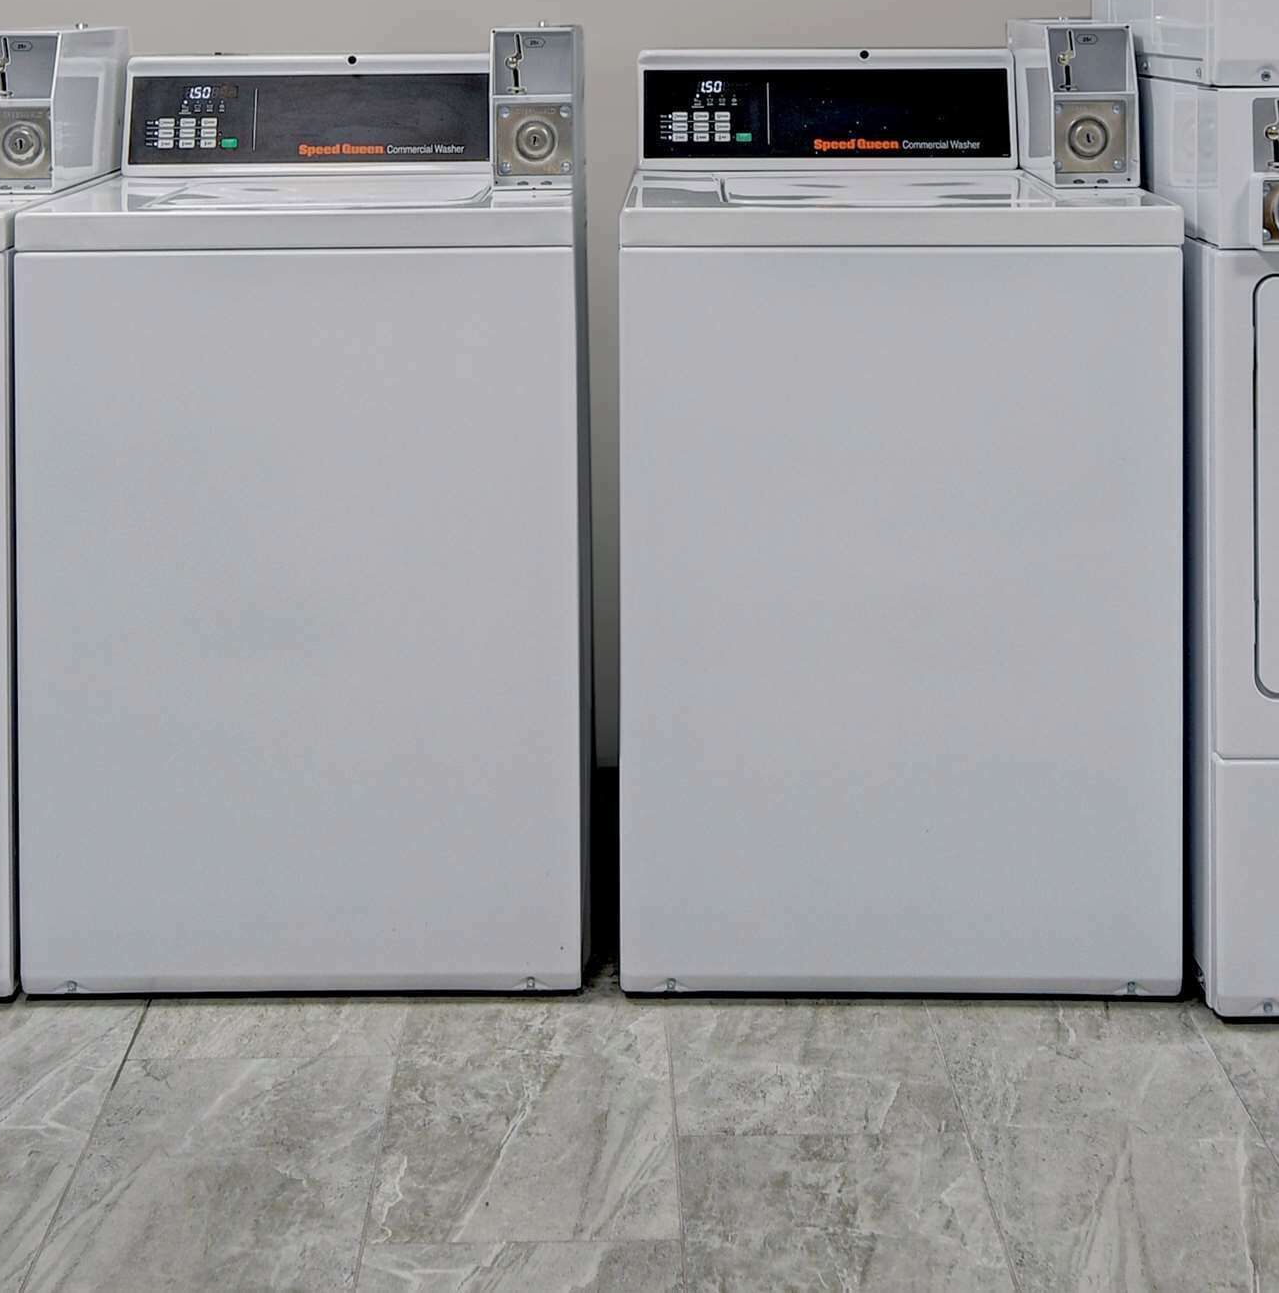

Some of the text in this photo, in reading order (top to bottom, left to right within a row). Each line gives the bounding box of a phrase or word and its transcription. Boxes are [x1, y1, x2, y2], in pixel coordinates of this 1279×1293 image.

[298, 144, 464, 157] Speed Queen Commercial Washer
[813, 139, 981, 152] Speed Queen Commercial Washer
